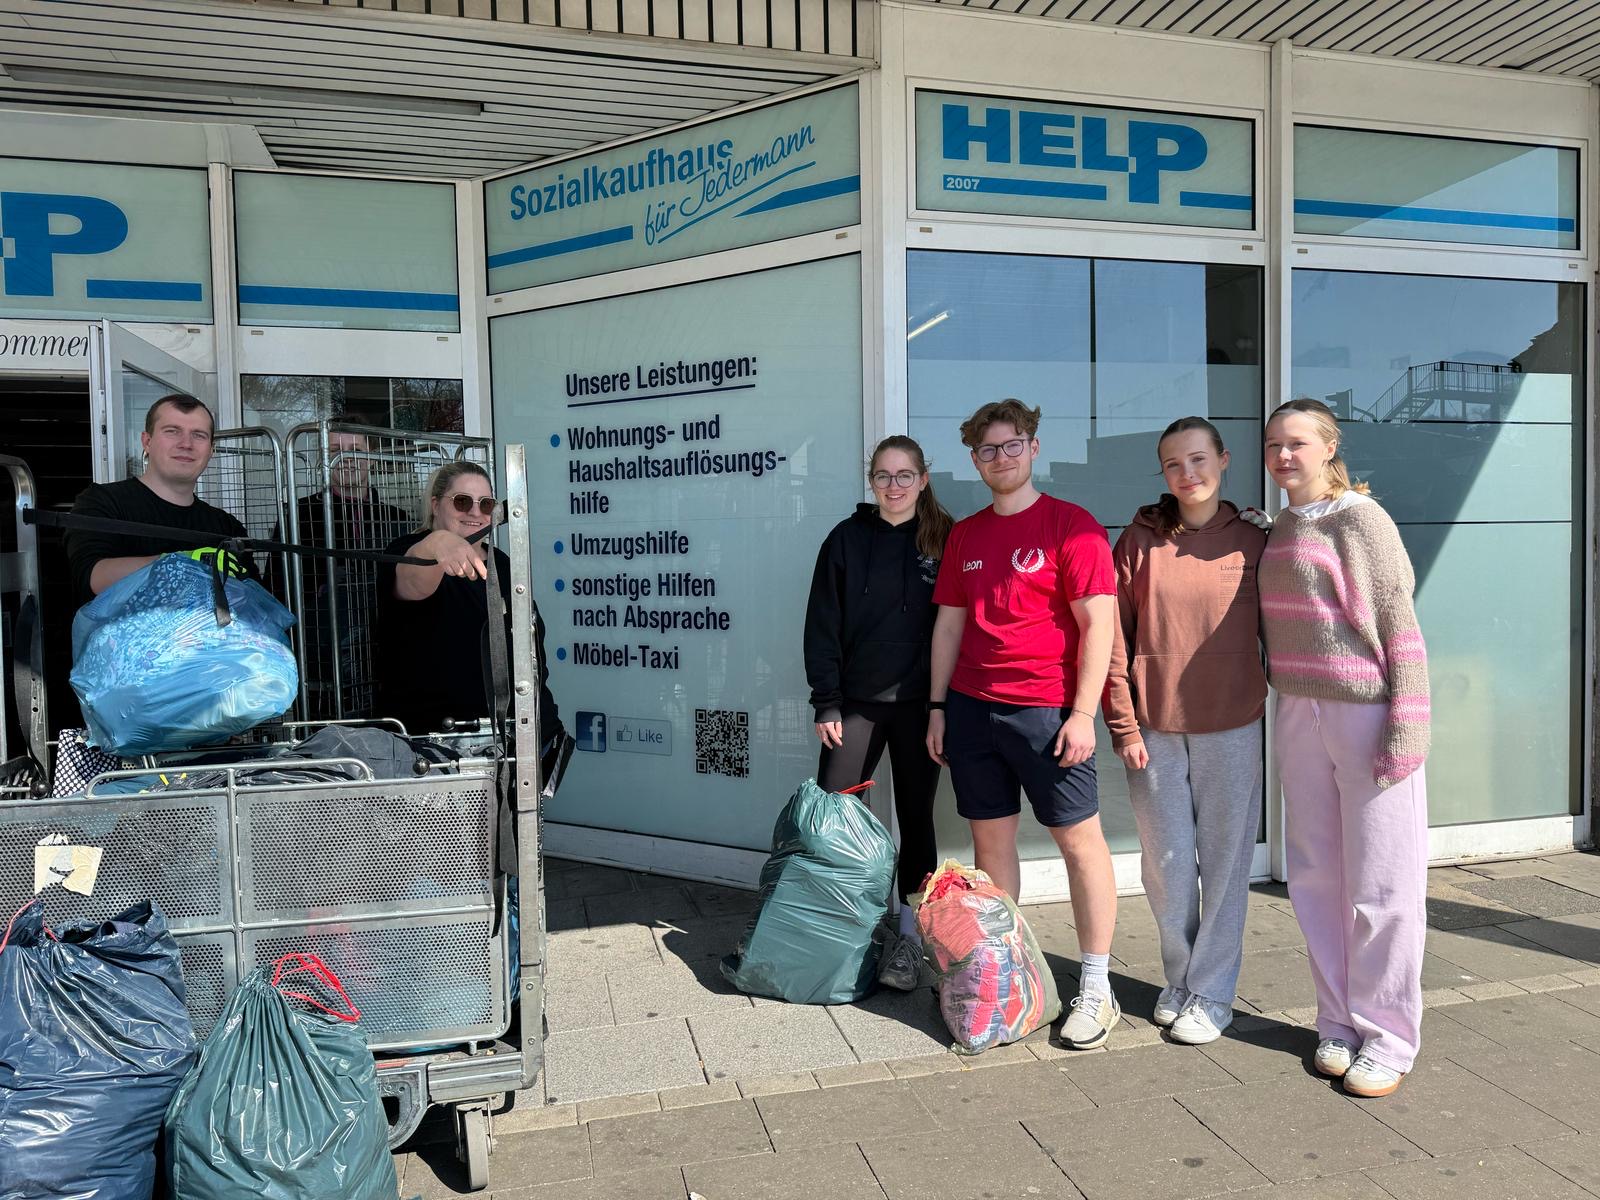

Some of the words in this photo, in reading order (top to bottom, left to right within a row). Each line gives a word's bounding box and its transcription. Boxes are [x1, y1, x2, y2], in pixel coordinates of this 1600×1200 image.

[942, 103, 1208, 205] HELP
[510, 138, 735, 221] Sozialkaufhaus
[644, 202, 676, 246] für
[679, 124, 816, 217] Jedermann
[945, 176, 981, 191] 2007
[0, 190, 129, 297] P
[565, 371, 631, 397] Unsere
[636, 356, 758, 389] Leistungen:
[567, 424, 676, 450] Wohnungs-
[682, 413, 721, 442] und
[569, 449, 788, 483] Haushaltsauflösungs-
[570, 490, 610, 515] hilfe
[571, 530, 690, 560] Umzugshilfe
[962, 559, 984, 573] Leon
[571, 573, 652, 601] sonstige
[657, 573, 717, 597] Hilfen
[572, 604, 618, 628] nach
[623, 605, 731, 634] Absprache
[572, 642, 680, 670] Möbel-Taxi
[637, 728, 664, 743] Like
